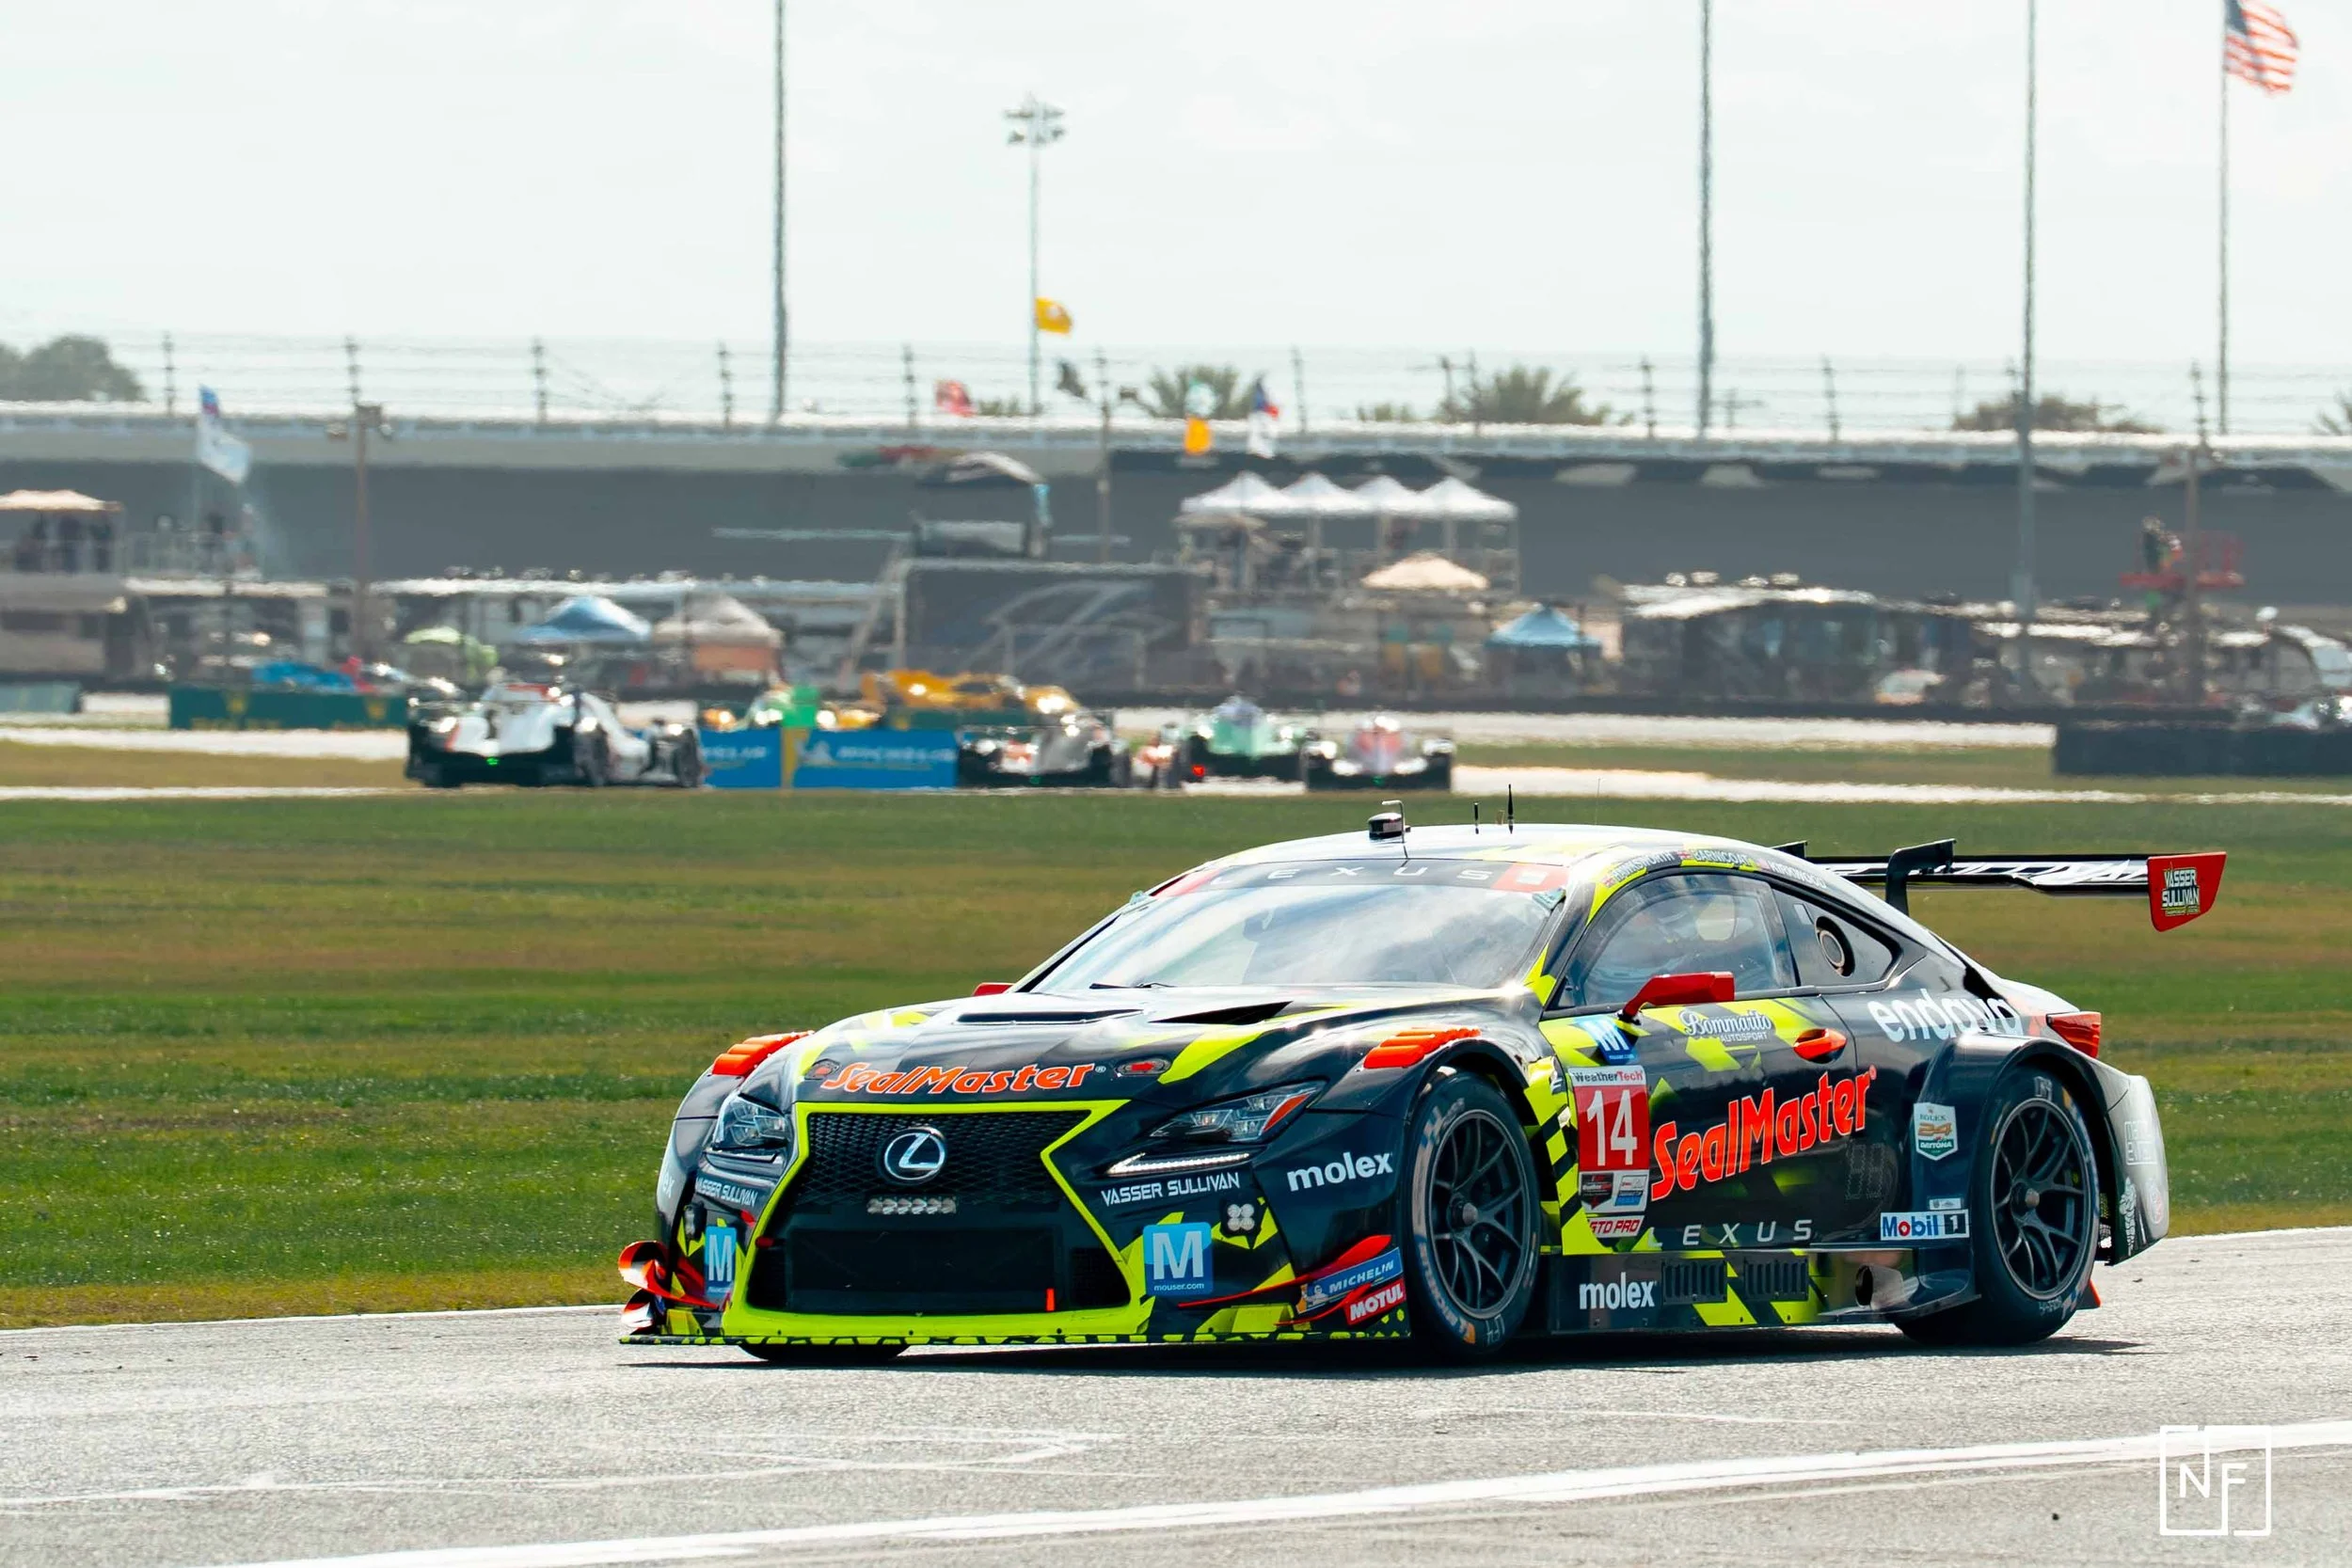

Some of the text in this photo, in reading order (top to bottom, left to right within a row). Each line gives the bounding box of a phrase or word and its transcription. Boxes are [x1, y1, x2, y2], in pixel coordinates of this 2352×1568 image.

[1209, 866, 1493, 886] LEXUS
[2164, 868, 2197, 889] VASSER
[2161, 885, 2201, 908] SULLIVAN
[1678, 1008, 1772, 1036] Bommarito
[1719, 1031, 1768, 1042] AUTOSPORT
[819, 1061, 1096, 1095] SealMaster
[1574, 1070, 1644, 1083] WeatherTech
[1586, 1089, 1638, 1166] 14
[1651, 1070, 1871, 1202] SealMaster
[1920, 1141, 1953, 1149] DAYTONA
[1287, 1151, 1393, 1192] molex
[721, 1184, 758, 1208] SULLIVAN
[1101, 1172, 1241, 1207] VASSER SULLIVAN
[1590, 1219, 1641, 1234] GTD PRO
[1648, 1219, 1813, 1248] LEXUS
[1883, 1214, 1959, 1237] Mobil 1
[708, 1234, 733, 1282] M
[1152, 1230, 1204, 1280] M
[1153, 1282, 1205, 1291] mouser.com
[1328, 1259, 1394, 1293] MICHELIN
[1350, 1283, 1404, 1322] MOTUL
[1579, 1272, 1656, 1310] molex
